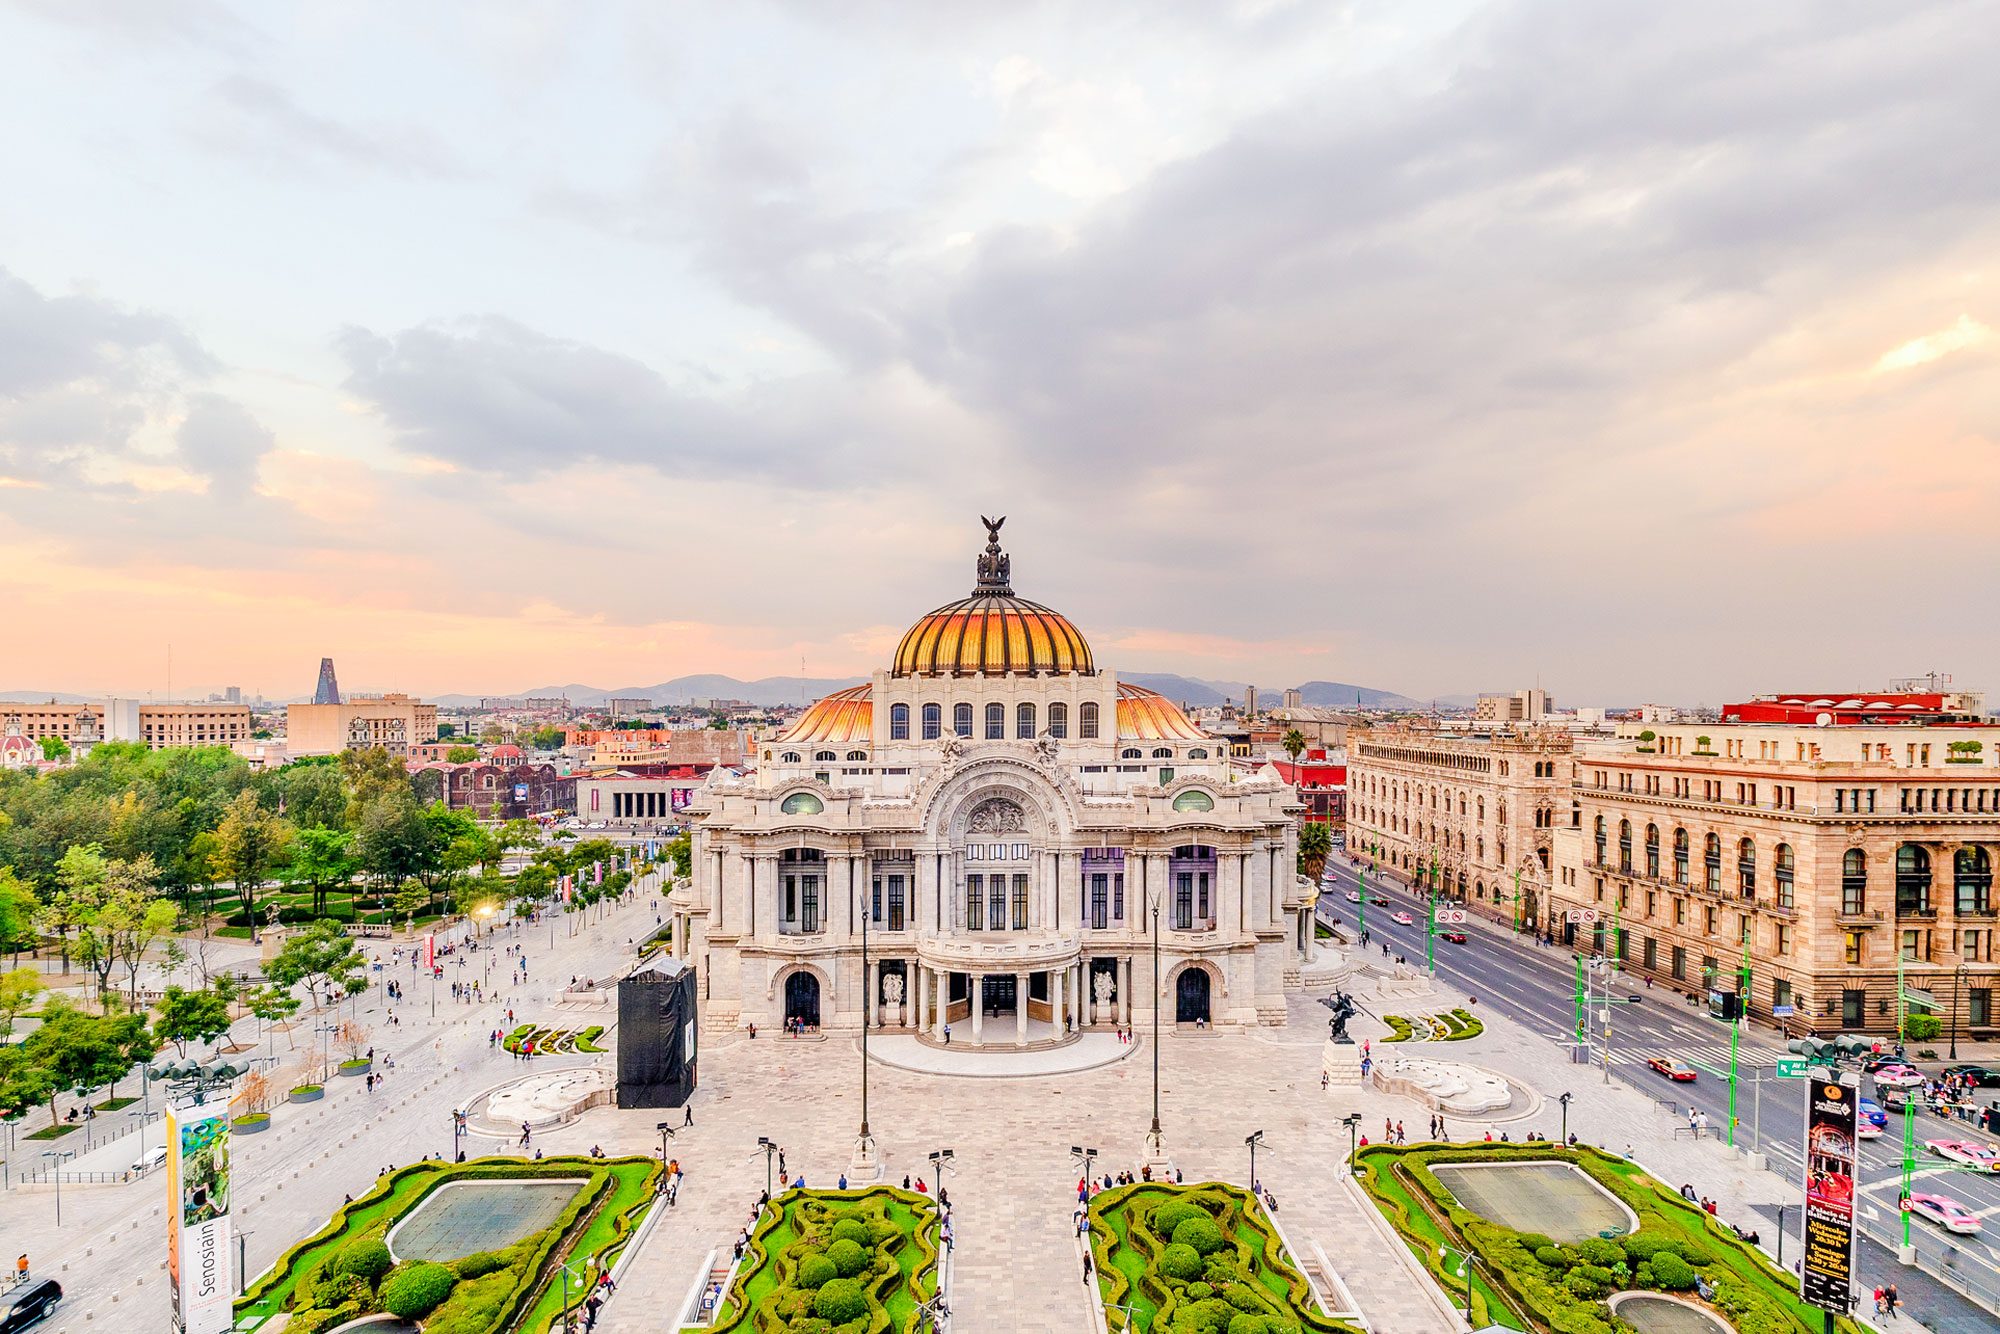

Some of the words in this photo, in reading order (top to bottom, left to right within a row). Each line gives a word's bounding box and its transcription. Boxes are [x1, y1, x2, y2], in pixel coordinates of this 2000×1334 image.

[993, 790, 1024, 804] BELLAS
[1807, 1209, 1830, 1221] Bellas
[1830, 1216, 1851, 1227] Artes
[1810, 1204, 1838, 1218] Palacio
[1838, 1212, 1849, 1220] de
[1808, 1225, 1849, 1244] Wednesday
[1810, 1220, 1847, 1236] Miércoles
[1815, 1234, 1836, 1246] 20:30
[1810, 1243, 1846, 1259] Domingo
[1813, 1250, 1842, 1265] Sunday
[197, 1223, 215, 1297] Senosiain
[1807, 1254, 1822, 1265] 9:30
[1828, 1262, 1849, 1273] 20:30
